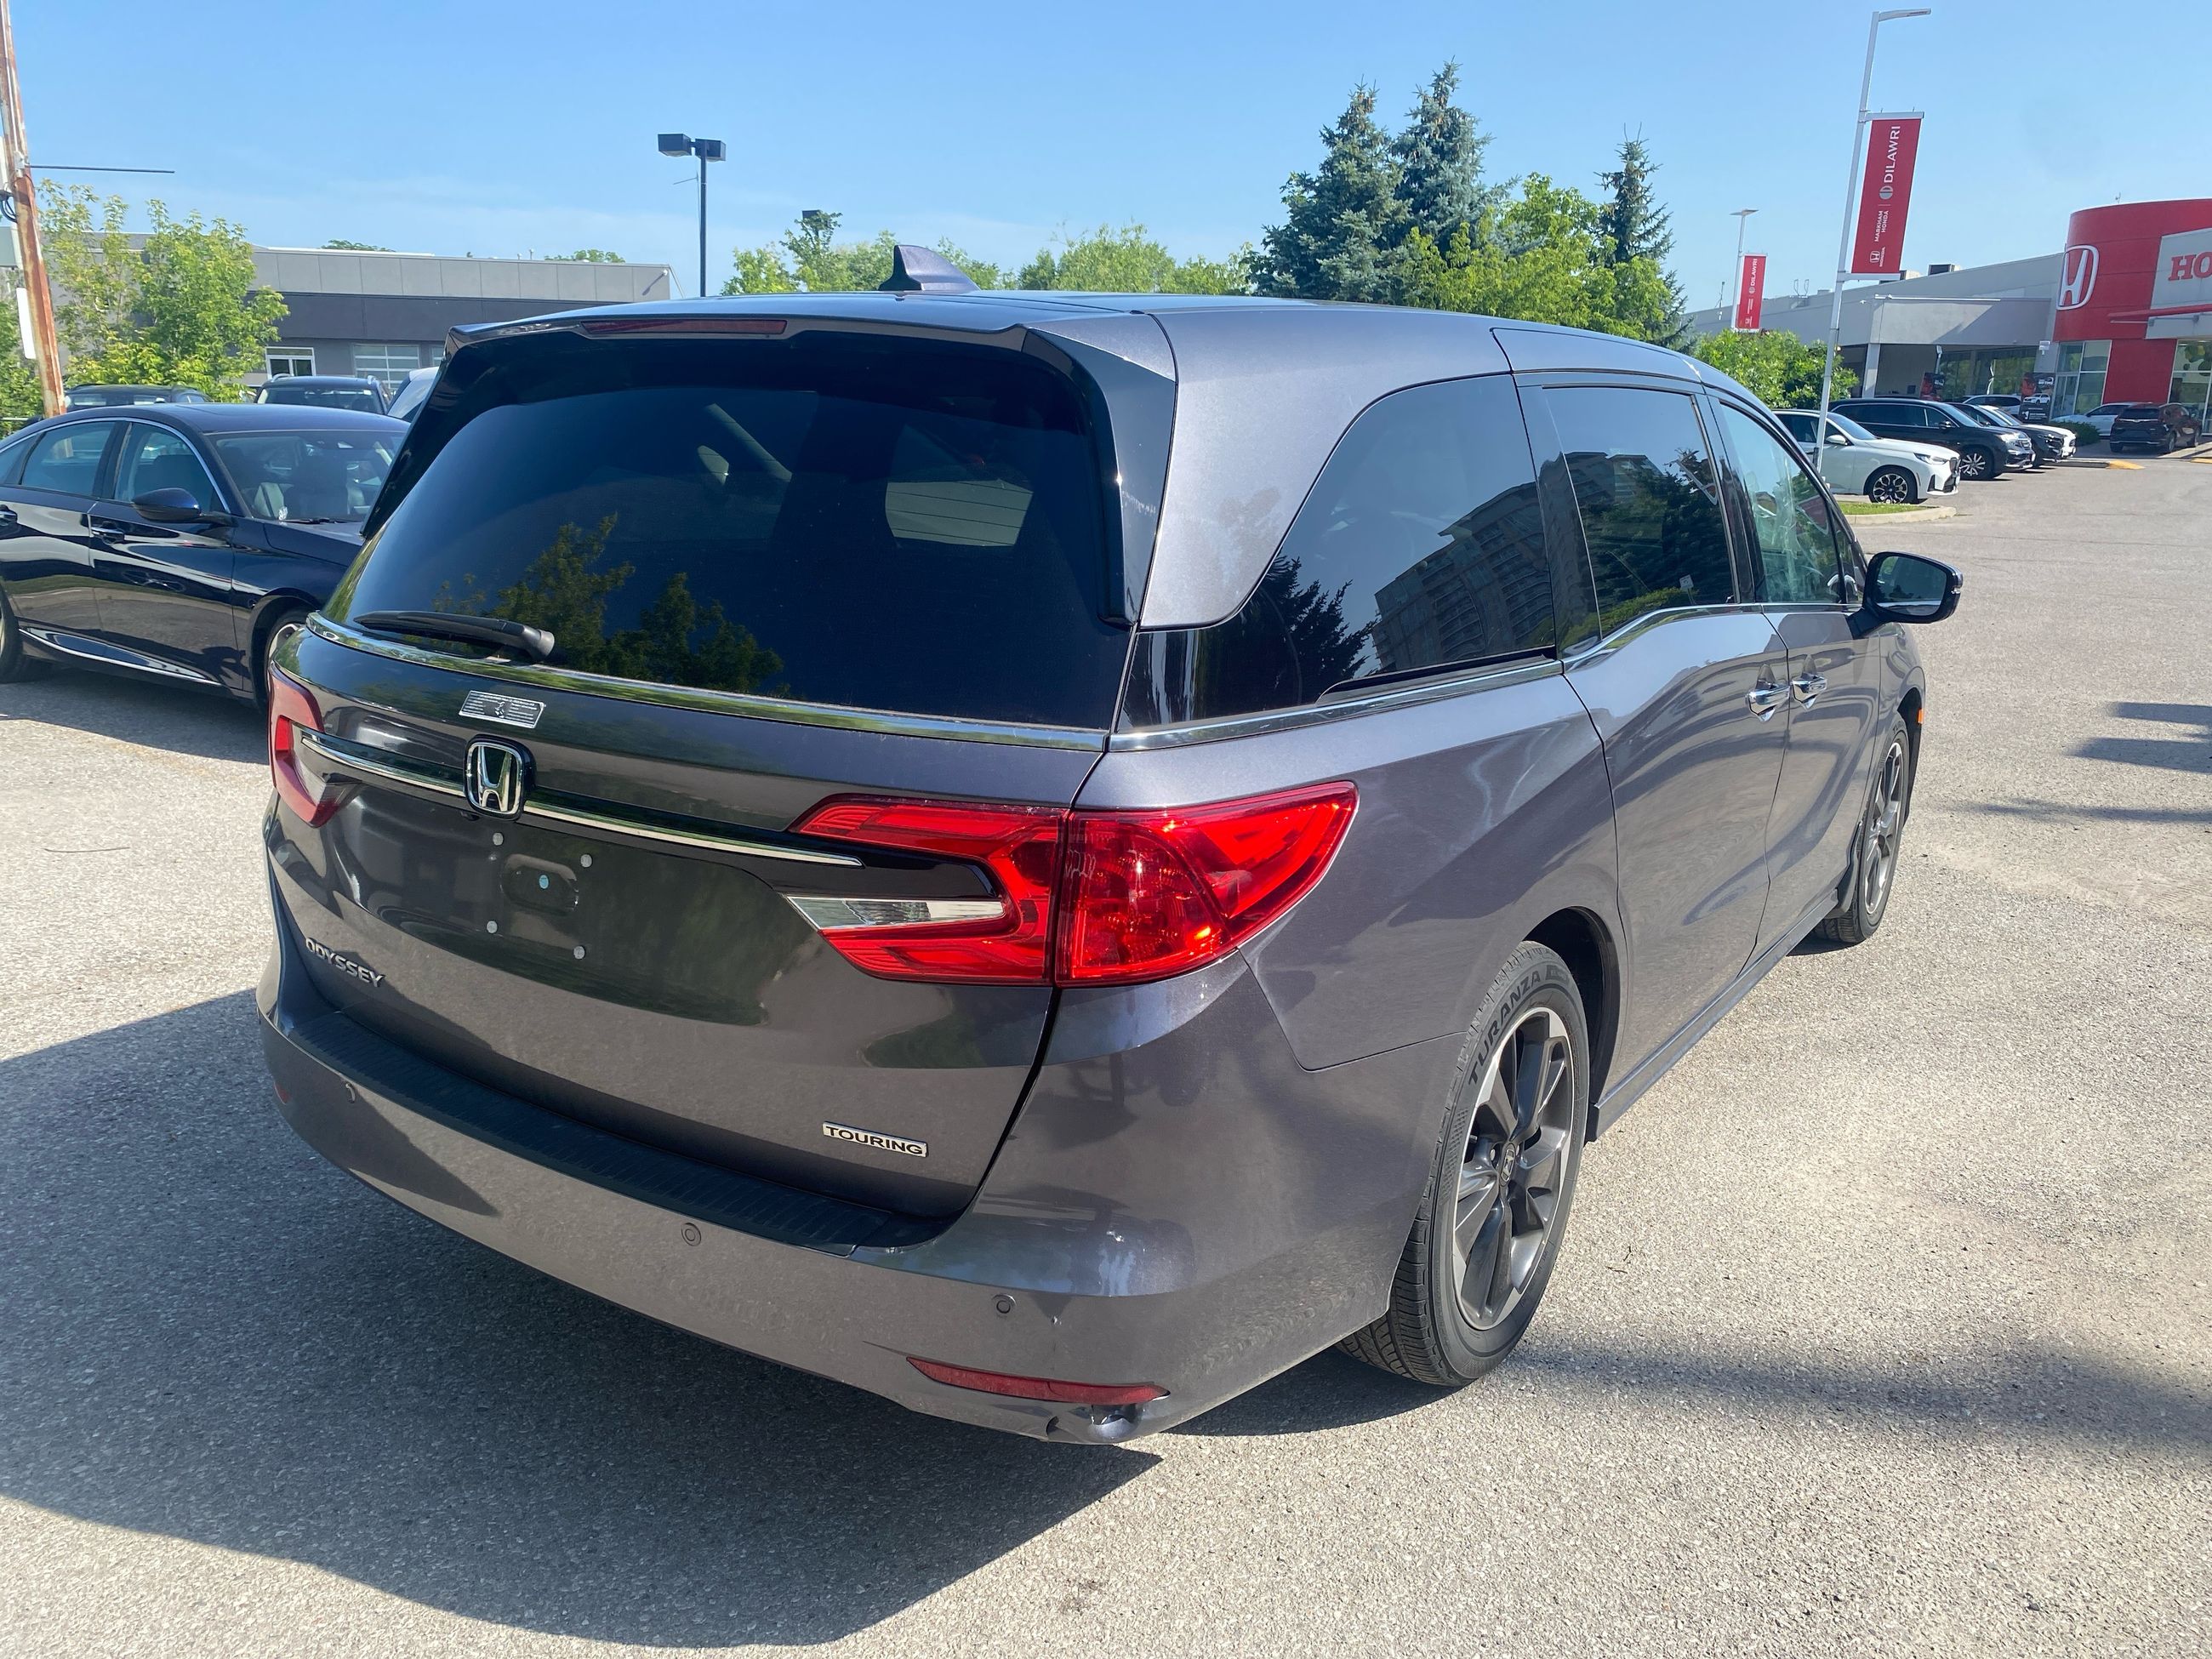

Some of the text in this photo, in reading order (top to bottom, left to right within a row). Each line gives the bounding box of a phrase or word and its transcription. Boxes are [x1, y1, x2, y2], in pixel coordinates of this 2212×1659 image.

[1884, 126, 1901, 183] DILAWRI
[1874, 210, 1883, 242] MARKHAM
[2169, 252, 2212, 281] HO
[306, 938, 385, 988] ODYSSEY
[1468, 970, 1541, 1086] TURANZA
[825, 1126, 923, 1154] TOURING
